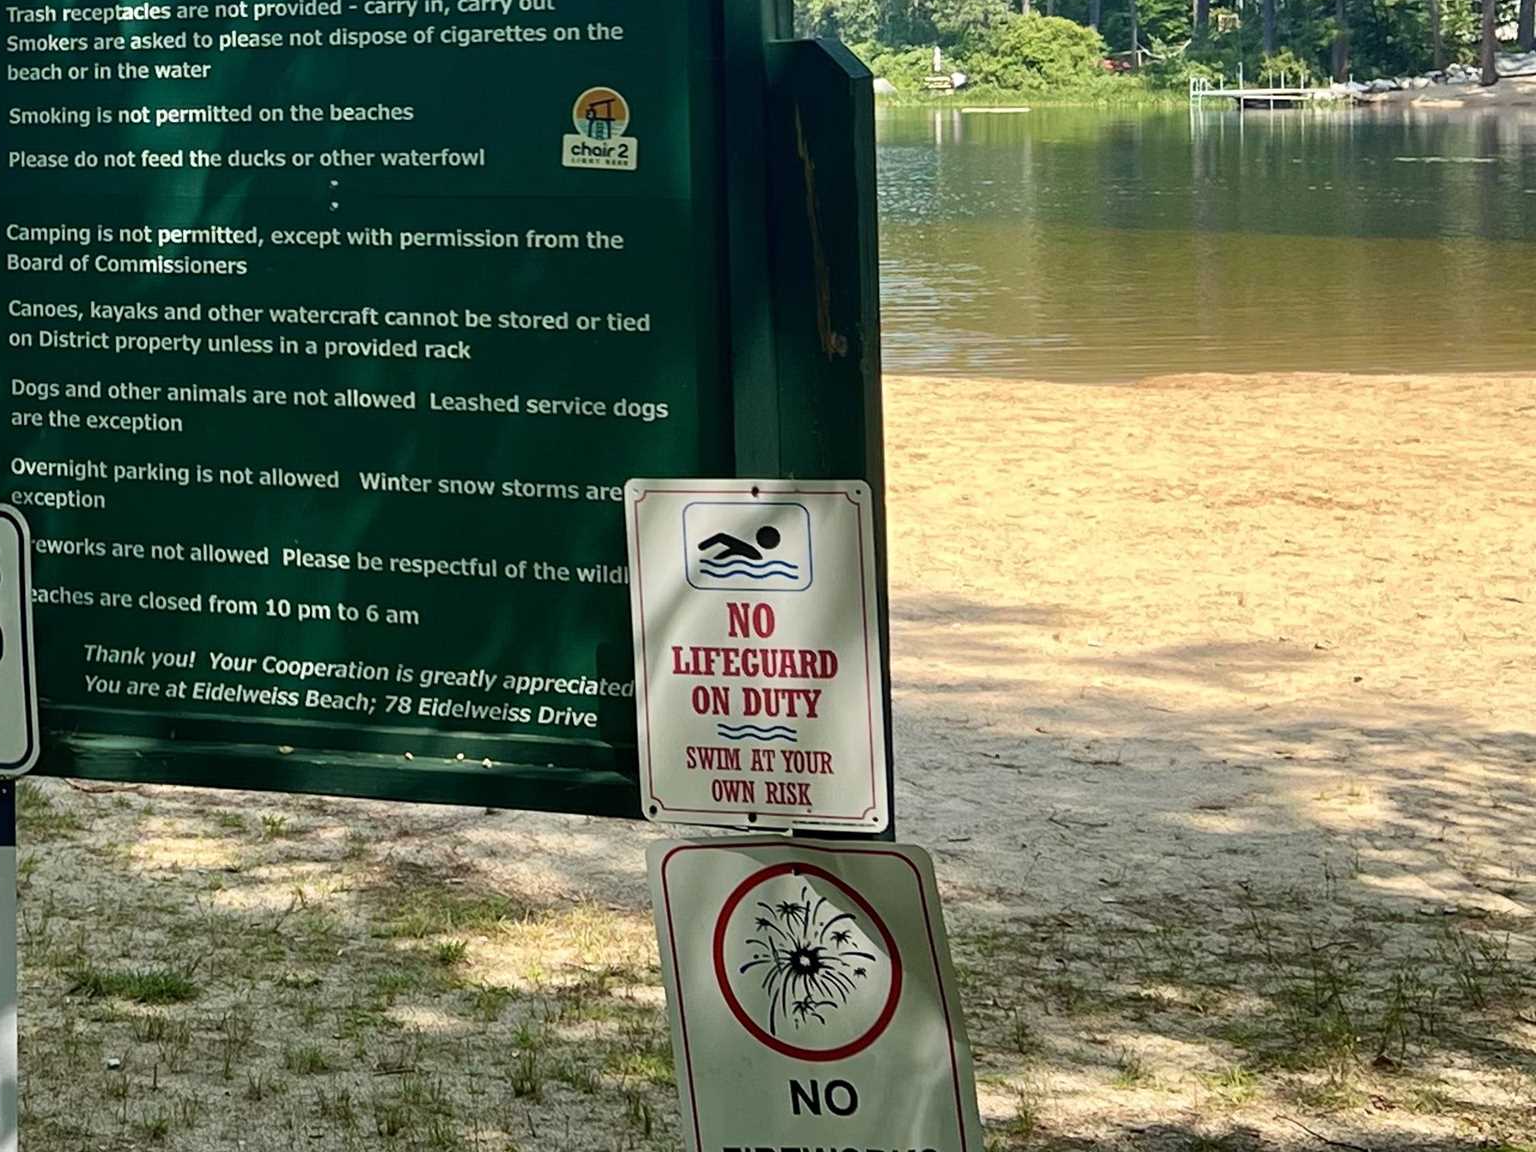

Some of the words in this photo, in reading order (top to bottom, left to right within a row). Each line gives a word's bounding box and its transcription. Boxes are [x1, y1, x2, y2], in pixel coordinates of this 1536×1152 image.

[9, 150, 69, 167] Please
[74, 150, 98, 167] do
[104, 150, 136, 167] not
[140, 149, 184, 167] feed
[188, 149, 222, 167] the
[227, 149, 287, 166] ducks
[291, 152, 315, 166] or
[319, 148, 376, 166] other
[380, 148, 485, 166] waterfowl
[570, 141, 616, 157] chair
[617, 143, 629, 159] 2
[6, 223, 91, 245] Camping
[97, 224, 114, 241] is
[119, 225, 153, 242] not
[157, 225, 264, 247] permitted,
[270, 227, 341, 248] except
[346, 227, 393, 245] with
[399, 228, 519, 249] permission
[525, 229, 579, 248] from
[585, 230, 624, 249] the
[7, 253, 64, 270] Board
[69, 254, 90, 271] of
[94, 254, 248, 274] Commissioners
[11, 457, 108, 480] Overnight
[113, 462, 190, 485] parking
[196, 464, 214, 482] is
[219, 467, 254, 484] not
[259, 467, 340, 488] allowed
[359, 472, 433, 492] Winter
[438, 479, 496, 495] snow
[501, 479, 580, 499] storms
[585, 484, 624, 502] are
[11, 490, 106, 509] exception
[34, 538, 107, 557] eworks
[111, 542, 145, 558] are
[151, 543, 185, 560] not
[189, 543, 269, 564] allowed
[282, 548, 351, 569] Please
[357, 551, 383, 570] be
[389, 557, 497, 577] respectful
[504, 560, 528, 578] of
[533, 561, 570, 581] the
[577, 565, 630, 584] wildl
[31, 587, 94, 606] eaches
[99, 592, 133, 607] are
[138, 591, 202, 611] closed
[208, 594, 258, 615] from
[265, 598, 291, 617] 10
[297, 603, 331, 621] pm
[337, 602, 360, 620] to
[366, 604, 380, 622] 6
[385, 608, 419, 624] am
[727, 601, 776, 639] NO
[84, 644, 146, 664] Thank
[151, 650, 196, 669] you!
[209, 651, 258, 671] Your
[262, 655, 390, 680] Cooperation
[396, 663, 414, 682] is
[419, 669, 498, 691] greatly
[503, 676, 634, 698] appreciated
[671, 645, 839, 679] LIFEGUARD
[85, 674, 121, 693] You
[126, 680, 161, 696] are
[165, 680, 188, 698] at
[192, 682, 300, 706] Eidelweiss
[304, 689, 377, 714] Beach;
[385, 695, 413, 713] 78
[417, 697, 532, 722] Eidelweiss
[537, 705, 598, 727] Drive
[691, 685, 731, 716] ON
[743, 688, 823, 719] DUTY
[685, 746, 743, 773] SWIM
[750, 749, 777, 774] AT
[781, 749, 835, 776] YOUR
[711, 779, 756, 805] OWN
[765, 781, 813, 807] RISK
[789, 1079, 859, 1117] NO
